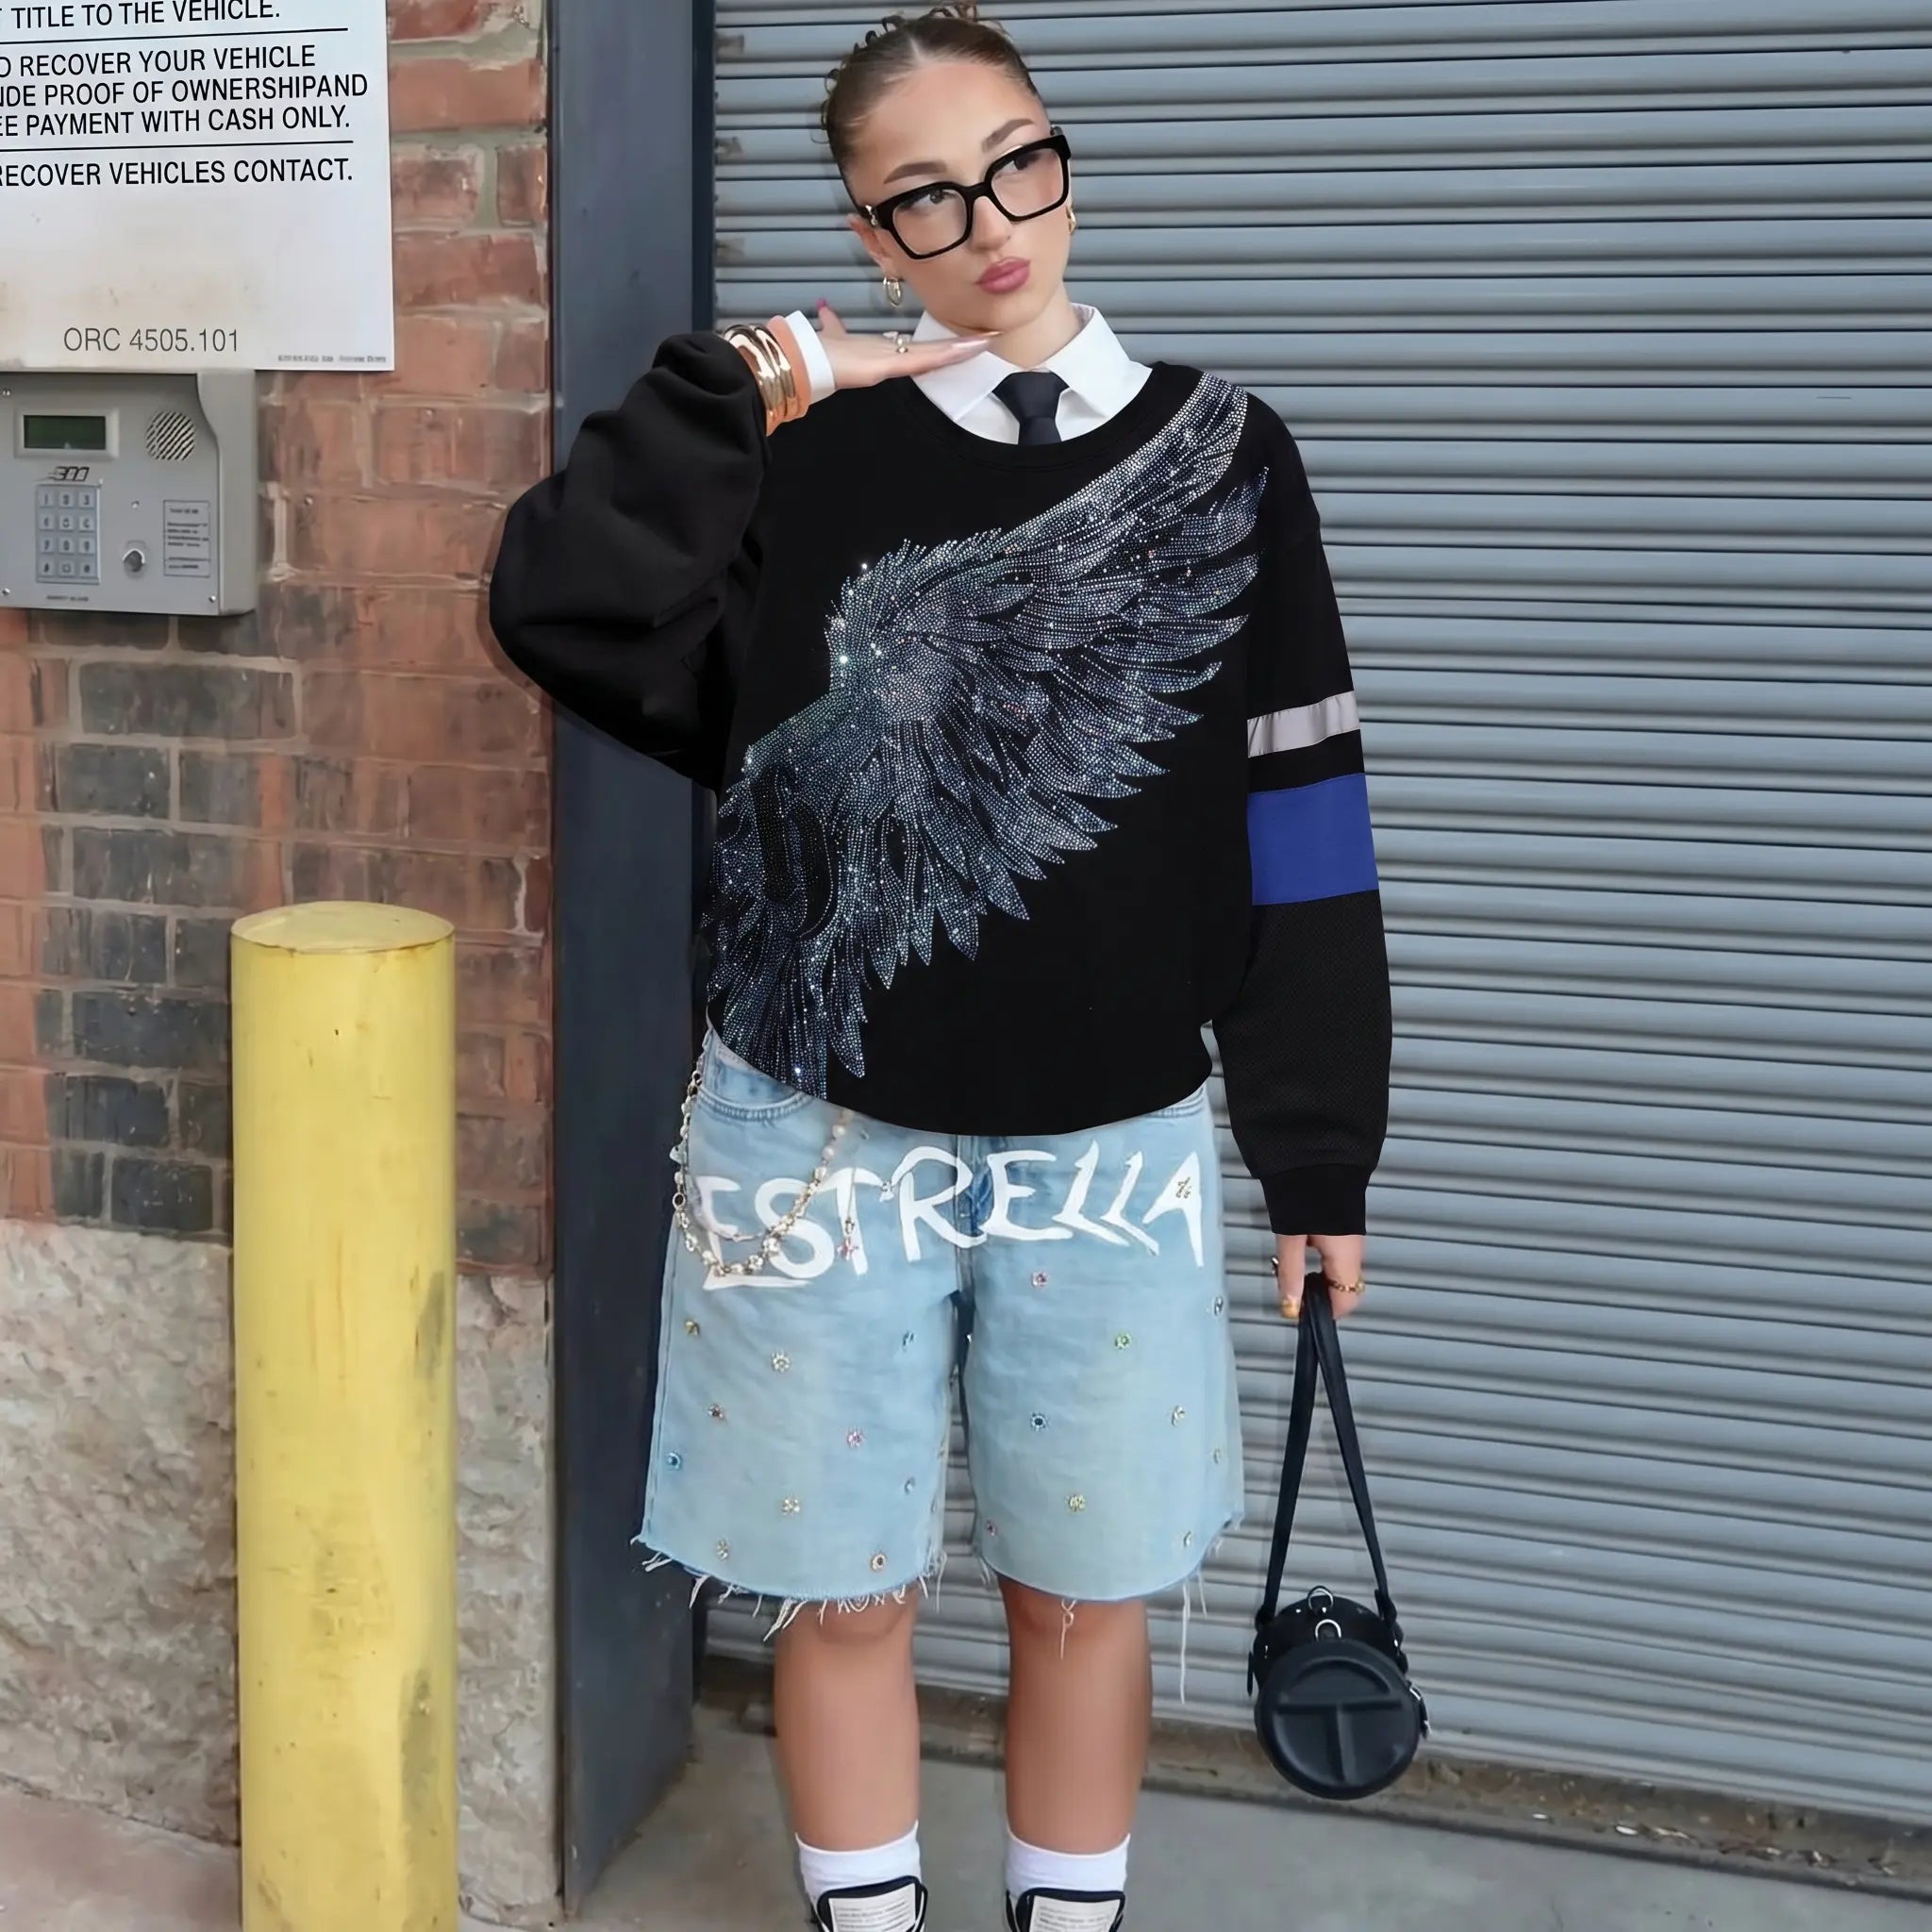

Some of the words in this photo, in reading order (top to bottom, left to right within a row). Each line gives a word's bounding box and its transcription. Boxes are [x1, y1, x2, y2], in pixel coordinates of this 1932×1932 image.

[11, 6, 75, 29] TITLE
[81, 4, 112, 26] TO
[118, 1, 165, 25] THE
[173, 0, 280, 23] VEHICLE.
[21, 52, 131, 76] RECOVER
[139, 49, 206, 73] YOUR
[214, 45, 316, 70] VEHICLE
[0, 86, 37, 108] DE
[45, 82, 125, 106] PROOF
[133, 81, 164, 103] OF
[27, 111, 135, 136] PAYMENT
[142, 109, 200, 133] WITH
[208, 108, 274, 131] CASH
[283, 105, 350, 129] ONLY.
[0, 163, 101, 187] ECOVER
[109, 160, 225, 185] VEHICLES
[234, 158, 353, 183] CONTACT.
[64, 327, 121, 352] ORC
[130, 328, 238, 352] 4505.101
[694, 1140, 1204, 1291] ESTRELLA
